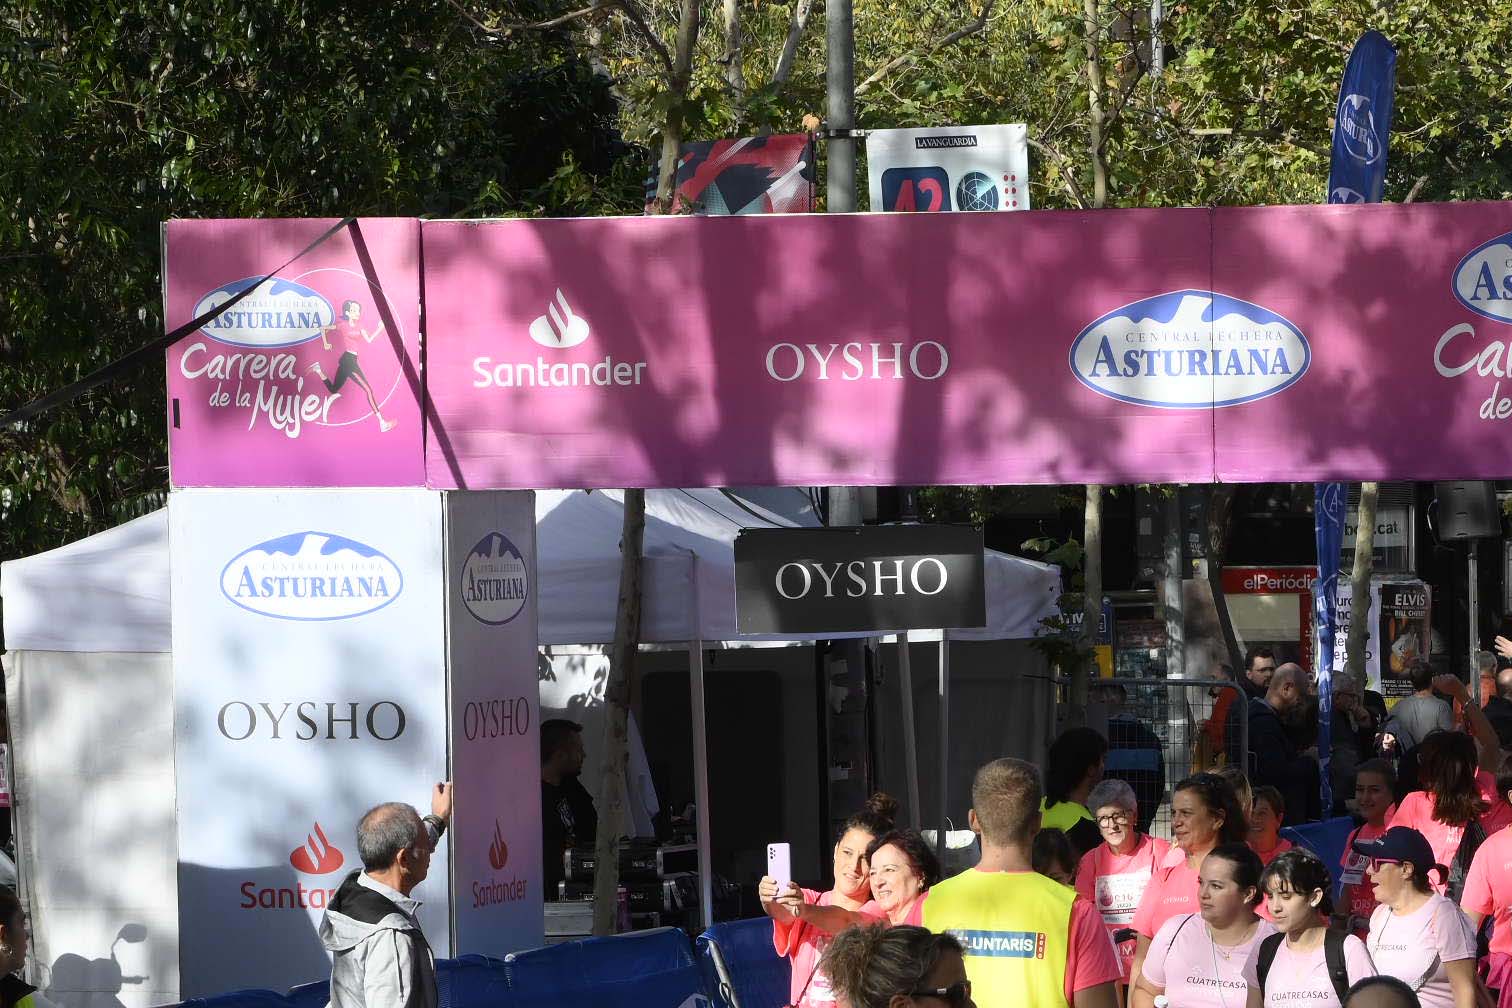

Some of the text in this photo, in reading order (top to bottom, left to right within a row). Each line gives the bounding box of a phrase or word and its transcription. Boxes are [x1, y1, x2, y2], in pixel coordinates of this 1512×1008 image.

[205, 302, 323, 329] ASTURIANA
[1125, 328, 1284, 344] CENTRAL LECHERA
[180, 342, 297, 380] Carrera
[473, 355, 647, 389] Santander
[765, 340, 949, 383] OYSHO
[1088, 335, 1293, 378] ASTURIANA
[209, 376, 342, 439] de la Mujer
[1479, 380, 1512, 421] de
[234, 564, 390, 599] ASTURIANA
[467, 568, 525, 602] ASTURIANA
[775, 556, 948, 600] OYSHO
[1394, 593, 1425, 607] ELVIS
[217, 700, 406, 741] OYSHO
[463, 696, 530, 741] OYSHO
[471, 877, 528, 909] Santander
[966, 936, 1033, 952] UNTARIS
[1271, 990, 1329, 1002] CUATRECASAS
